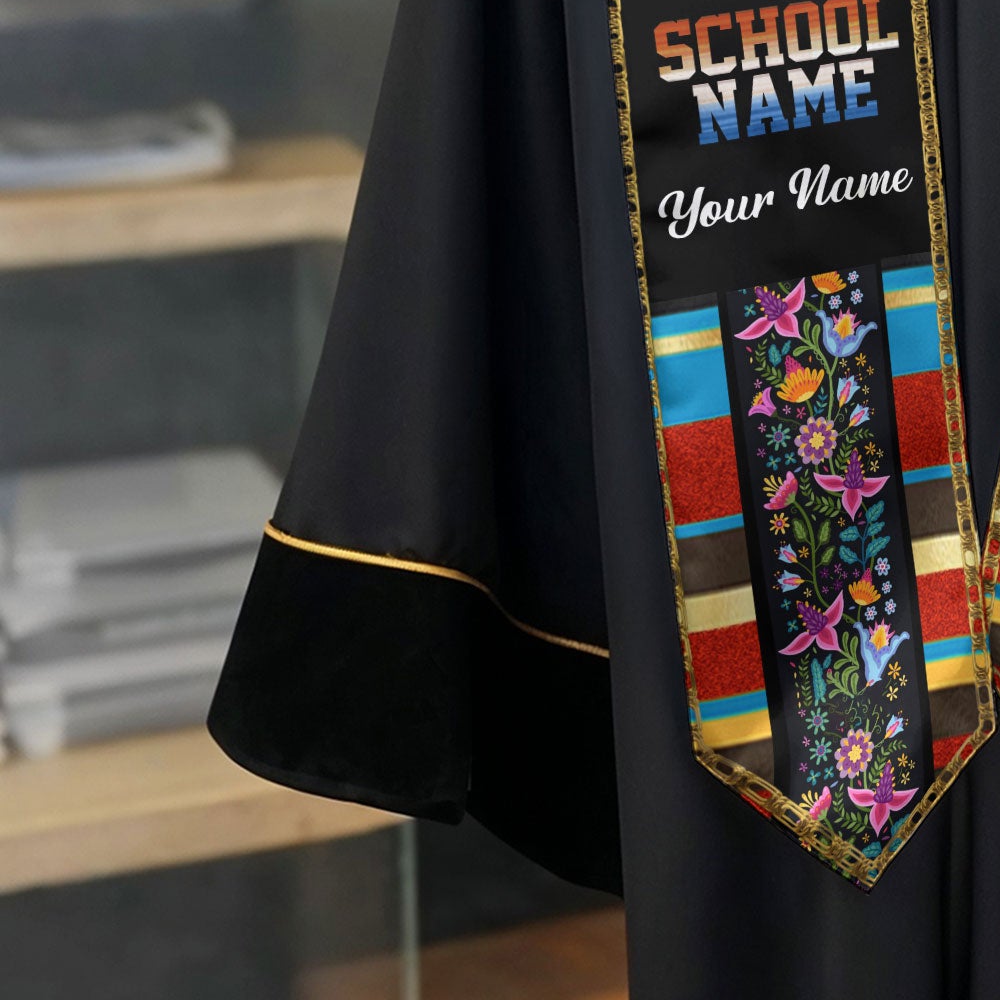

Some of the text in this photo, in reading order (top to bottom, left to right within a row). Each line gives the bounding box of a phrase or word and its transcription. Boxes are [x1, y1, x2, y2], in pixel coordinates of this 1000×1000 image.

[692, 58, 879, 145] NAME
[658, 164, 913, 239] Your Name
